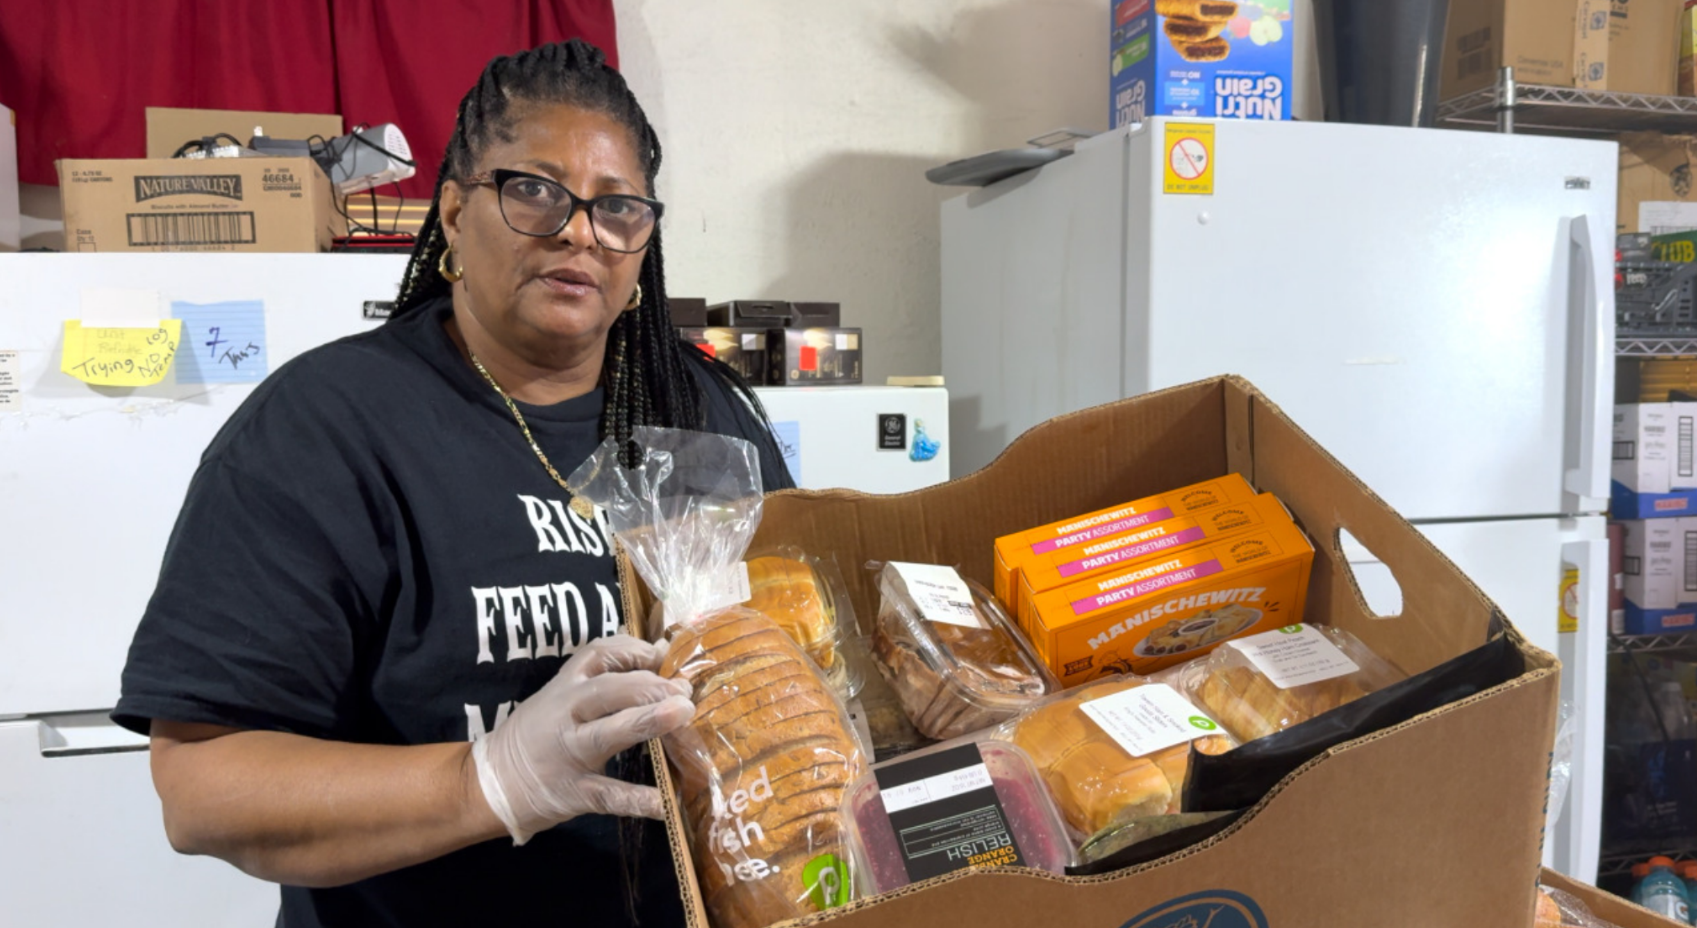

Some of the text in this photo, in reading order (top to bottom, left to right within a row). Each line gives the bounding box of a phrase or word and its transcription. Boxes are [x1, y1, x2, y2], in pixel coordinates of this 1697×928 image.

[1115, 80, 1146, 109] Grain
[1215, 76, 1283, 98] Grain
[1215, 95, 1282, 120] Nutri
[139, 178, 236, 198] NATURE VALLEY
[262, 174, 294, 183] 46684
[72, 357, 135, 378] Trying
[1055, 515, 1149, 548] PARTY ASSORTMENT
[1056, 507, 1136, 534] MANISCHEWITZ
[1082, 536, 1179, 569] PARTY ASSORTMENT
[1083, 527, 1166, 556] MANISCHEWITZ
[1096, 569, 1196, 606] PARTY ASSORTMENT
[1097, 559, 1182, 591] MANISCHEWITZ
[471, 581, 589, 665] FEED
[1087, 587, 1266, 650] MANISCHEWITZ
[947, 833, 1012, 861] RELISH
[966, 845, 1015, 865] ORANGE
